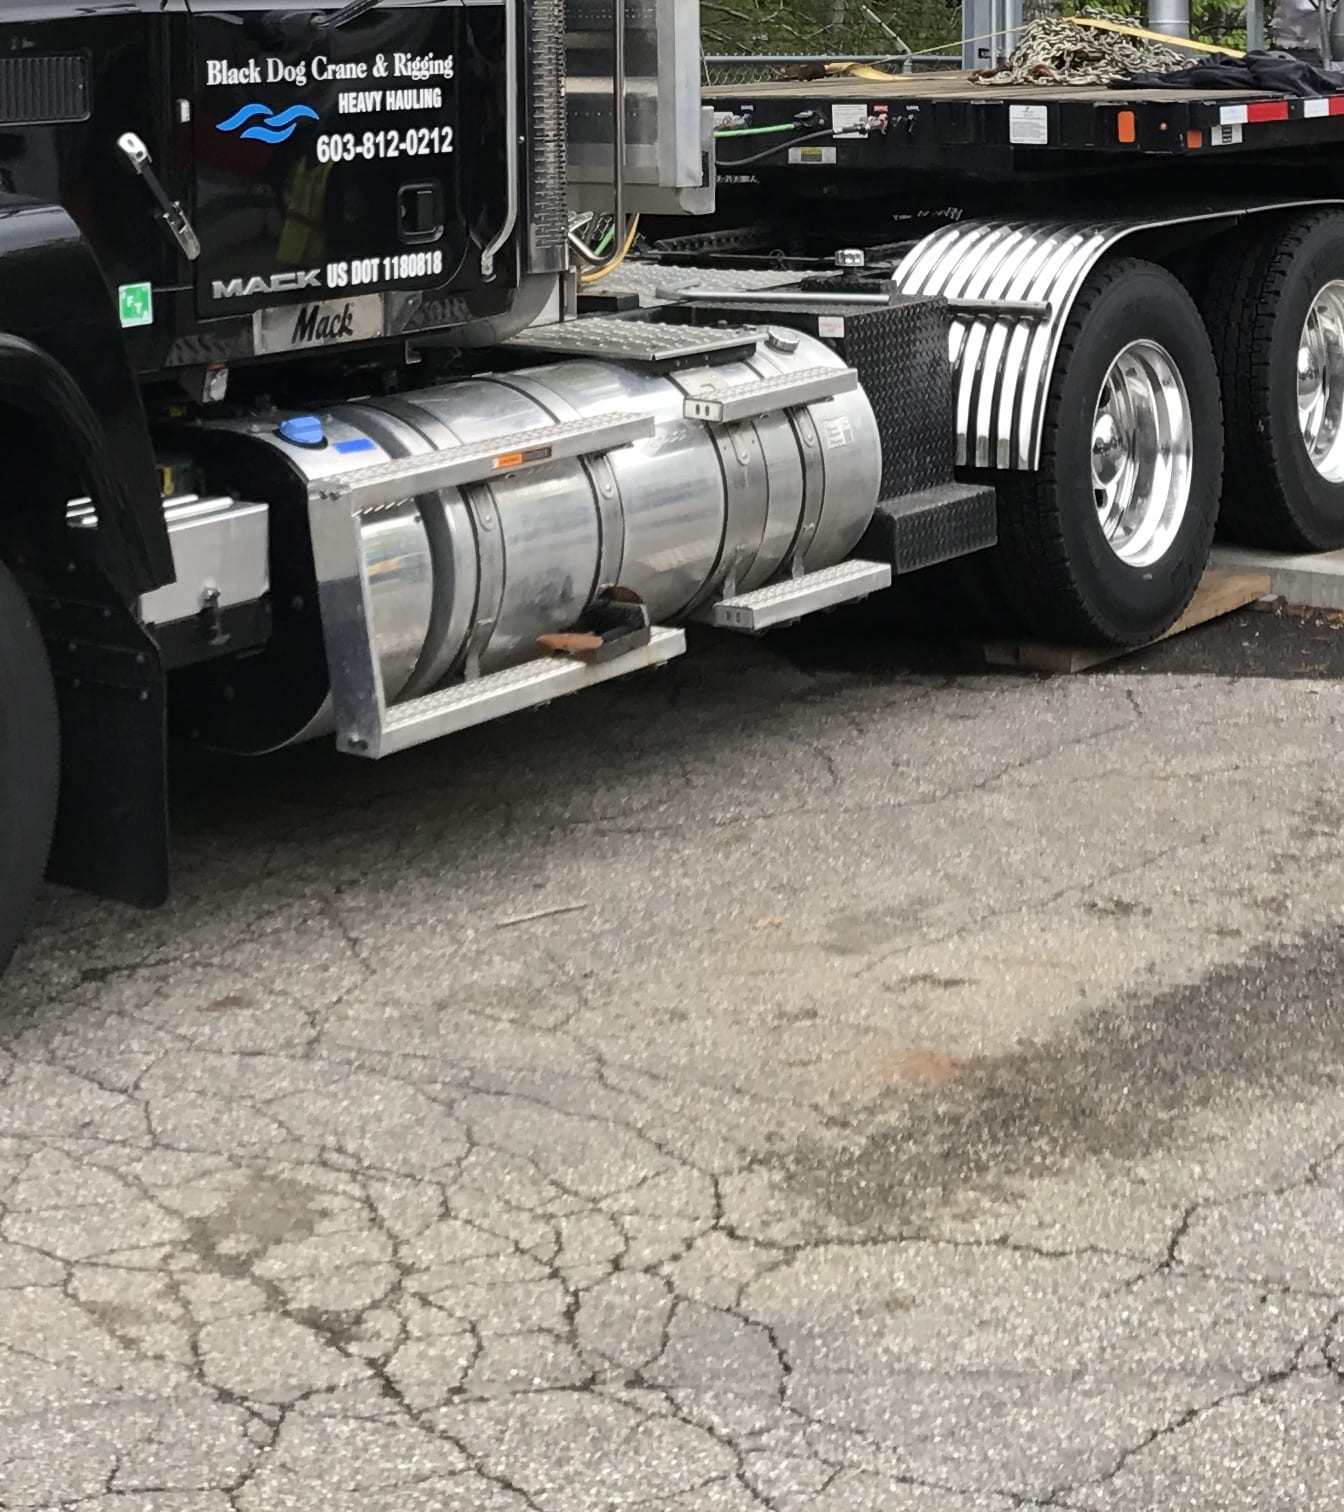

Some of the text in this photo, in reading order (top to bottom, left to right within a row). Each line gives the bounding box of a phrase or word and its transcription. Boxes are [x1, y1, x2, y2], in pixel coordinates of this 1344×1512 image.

[206, 52, 454, 86] Black Dog Crane & Rigging
[338, 87, 443, 114] HEAVY HAULING
[316, 126, 454, 163] 603-812-0212
[211, 268, 323, 299] MACK
[326, 250, 443, 288] US DOT 1180818
[291, 302, 354, 344] Mack
